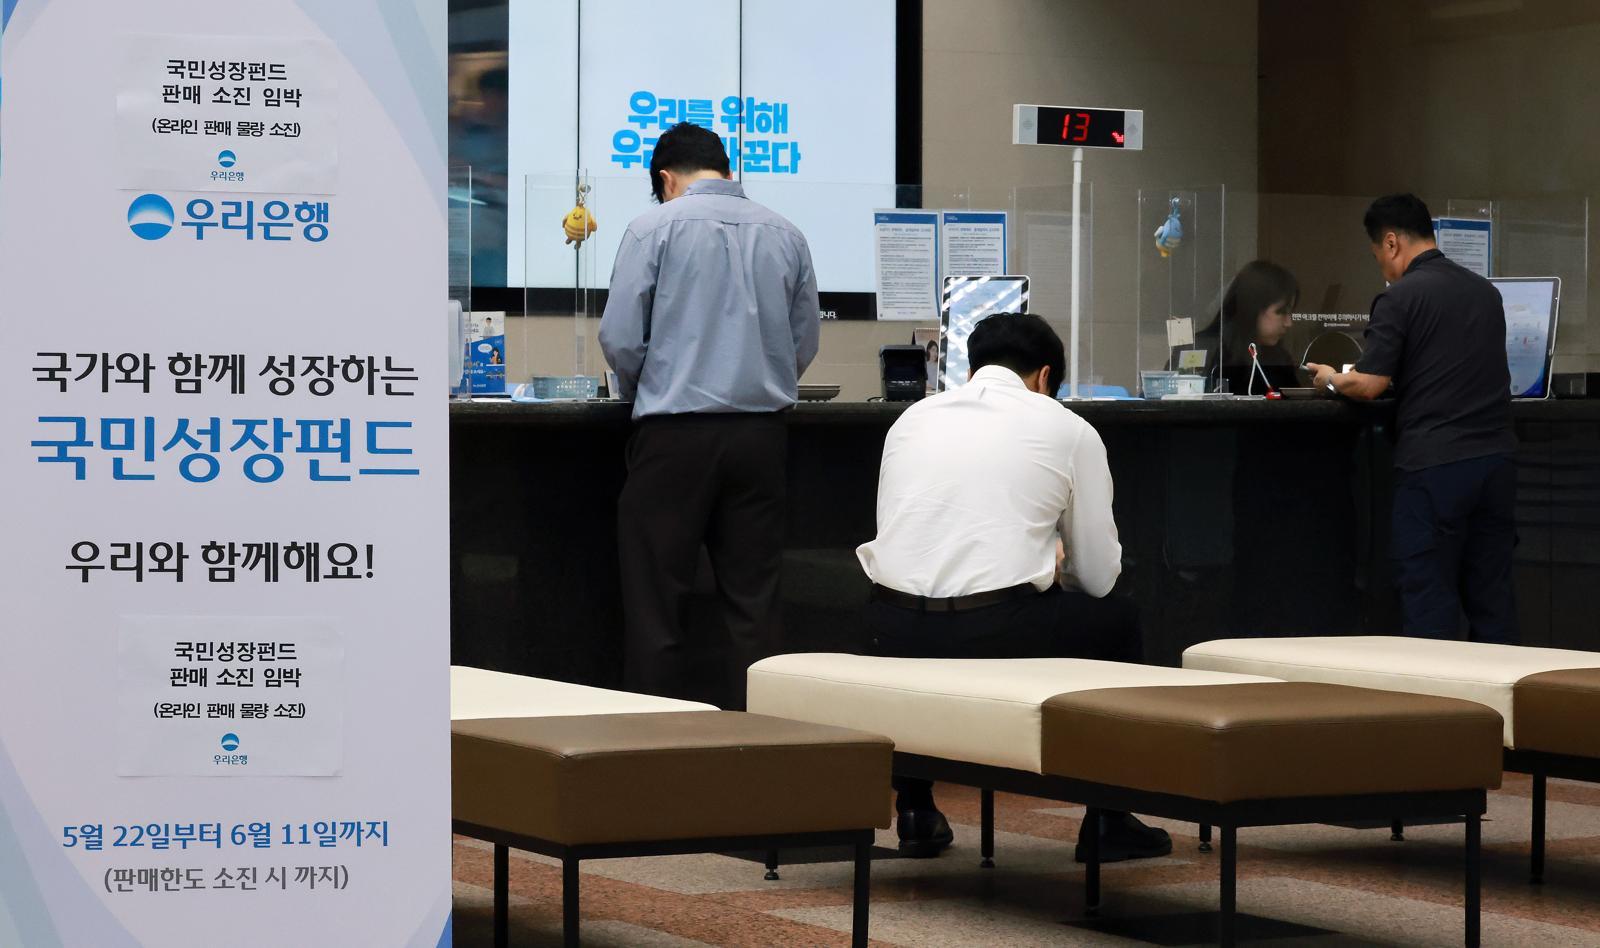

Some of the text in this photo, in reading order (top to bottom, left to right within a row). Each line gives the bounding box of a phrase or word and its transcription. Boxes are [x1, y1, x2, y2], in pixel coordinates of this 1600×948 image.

[166, 59, 288, 82] 국민성장펀드
[161, 84, 303, 109] 판매 소진 임박
[628, 91, 788, 134] 우리를 위해
[151, 117, 302, 138] (온라인 판매 물량 소진)
[1061, 113, 1091, 142] 13
[210, 170, 245, 182] 우리은행
[180, 198, 329, 243] 우리은행
[31, 351, 419, 397] 국가와 함께 성장하는
[30, 415, 421, 484] 국민성장펀드
[64, 540, 374, 584] 우리와 함께해요!
[173, 641, 298, 663] 국민성장펀드
[169, 667, 303, 689] 판매 소진 임박
[153, 701, 306, 720] (온라인 판매 물량 소진)
[213, 754, 248, 766] 우리은행
[62, 820, 389, 851] 5월 22일부터 6월 11일까지
[104, 864, 349, 894] (판매한도 소진 시 까지)
